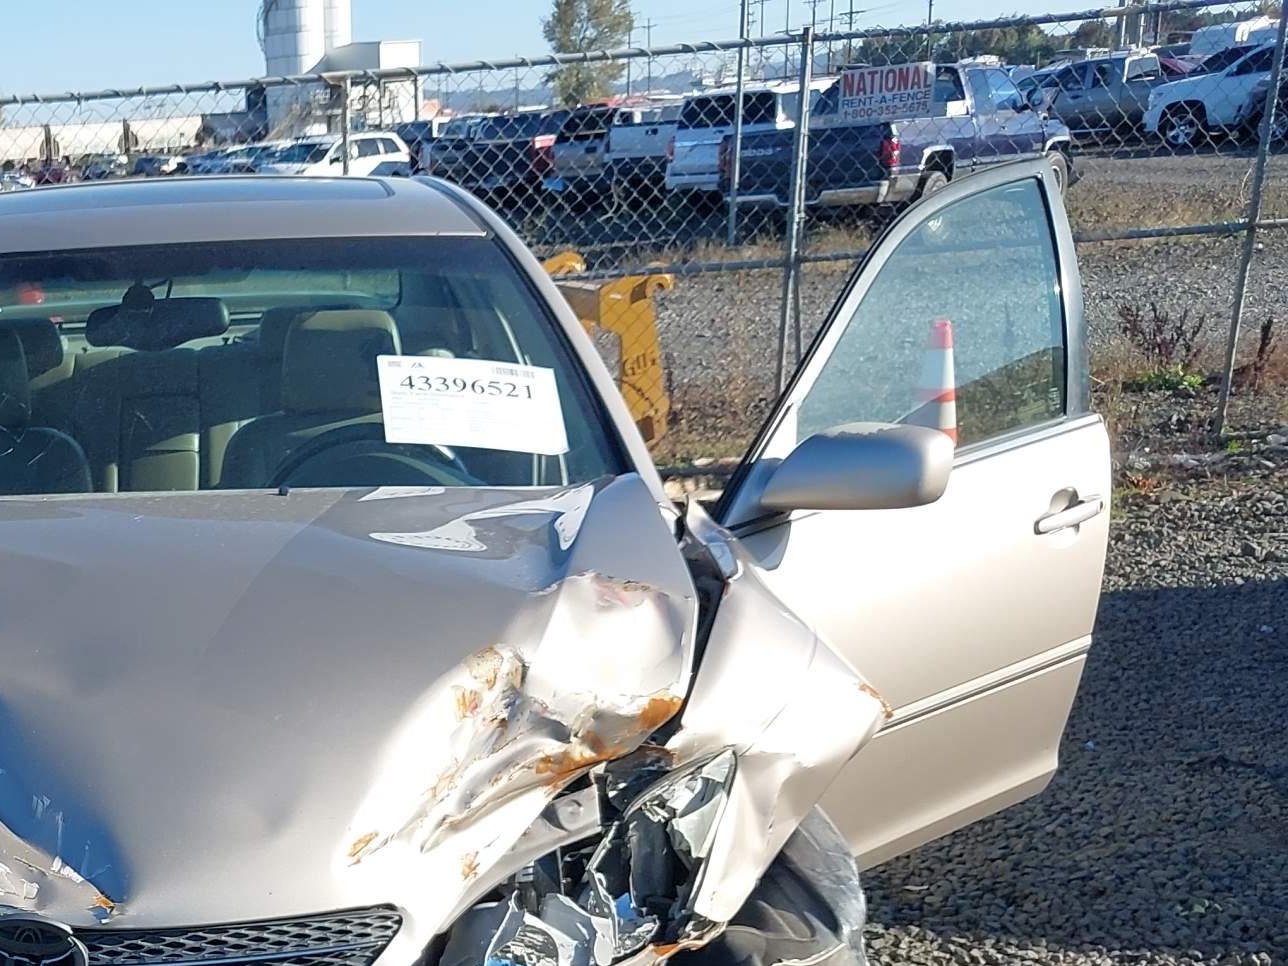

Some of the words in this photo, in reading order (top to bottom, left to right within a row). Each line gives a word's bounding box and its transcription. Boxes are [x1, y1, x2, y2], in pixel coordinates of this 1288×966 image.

[843, 65, 931, 98] NATIONAL
[842, 89, 931, 109] RENT-A-FENCE
[400, 375, 533, 399] 43396521
